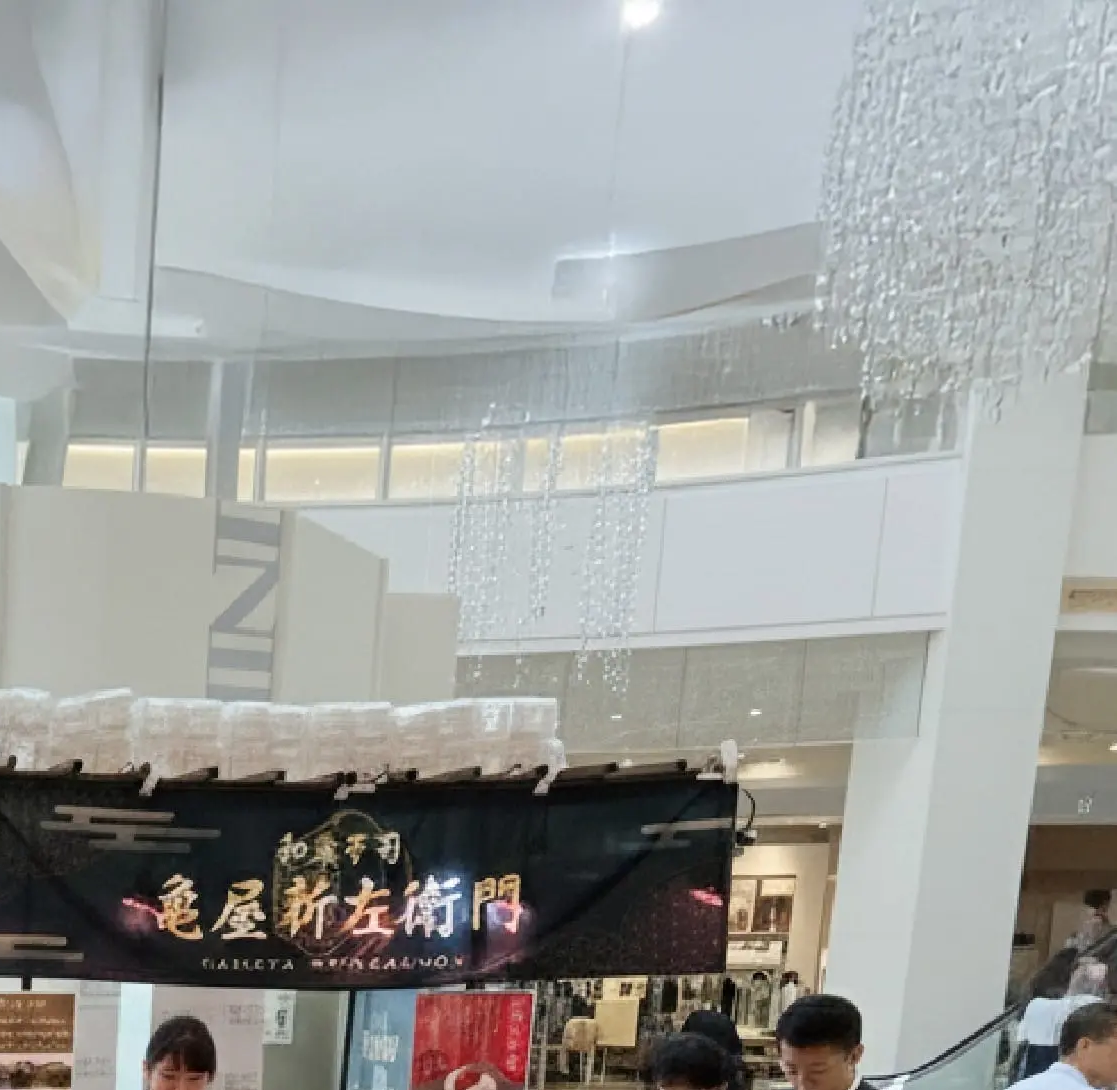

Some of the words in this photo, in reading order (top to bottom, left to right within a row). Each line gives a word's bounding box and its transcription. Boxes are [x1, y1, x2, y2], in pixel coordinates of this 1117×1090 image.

[157, 872, 523, 940] 亀屋新左衛門
